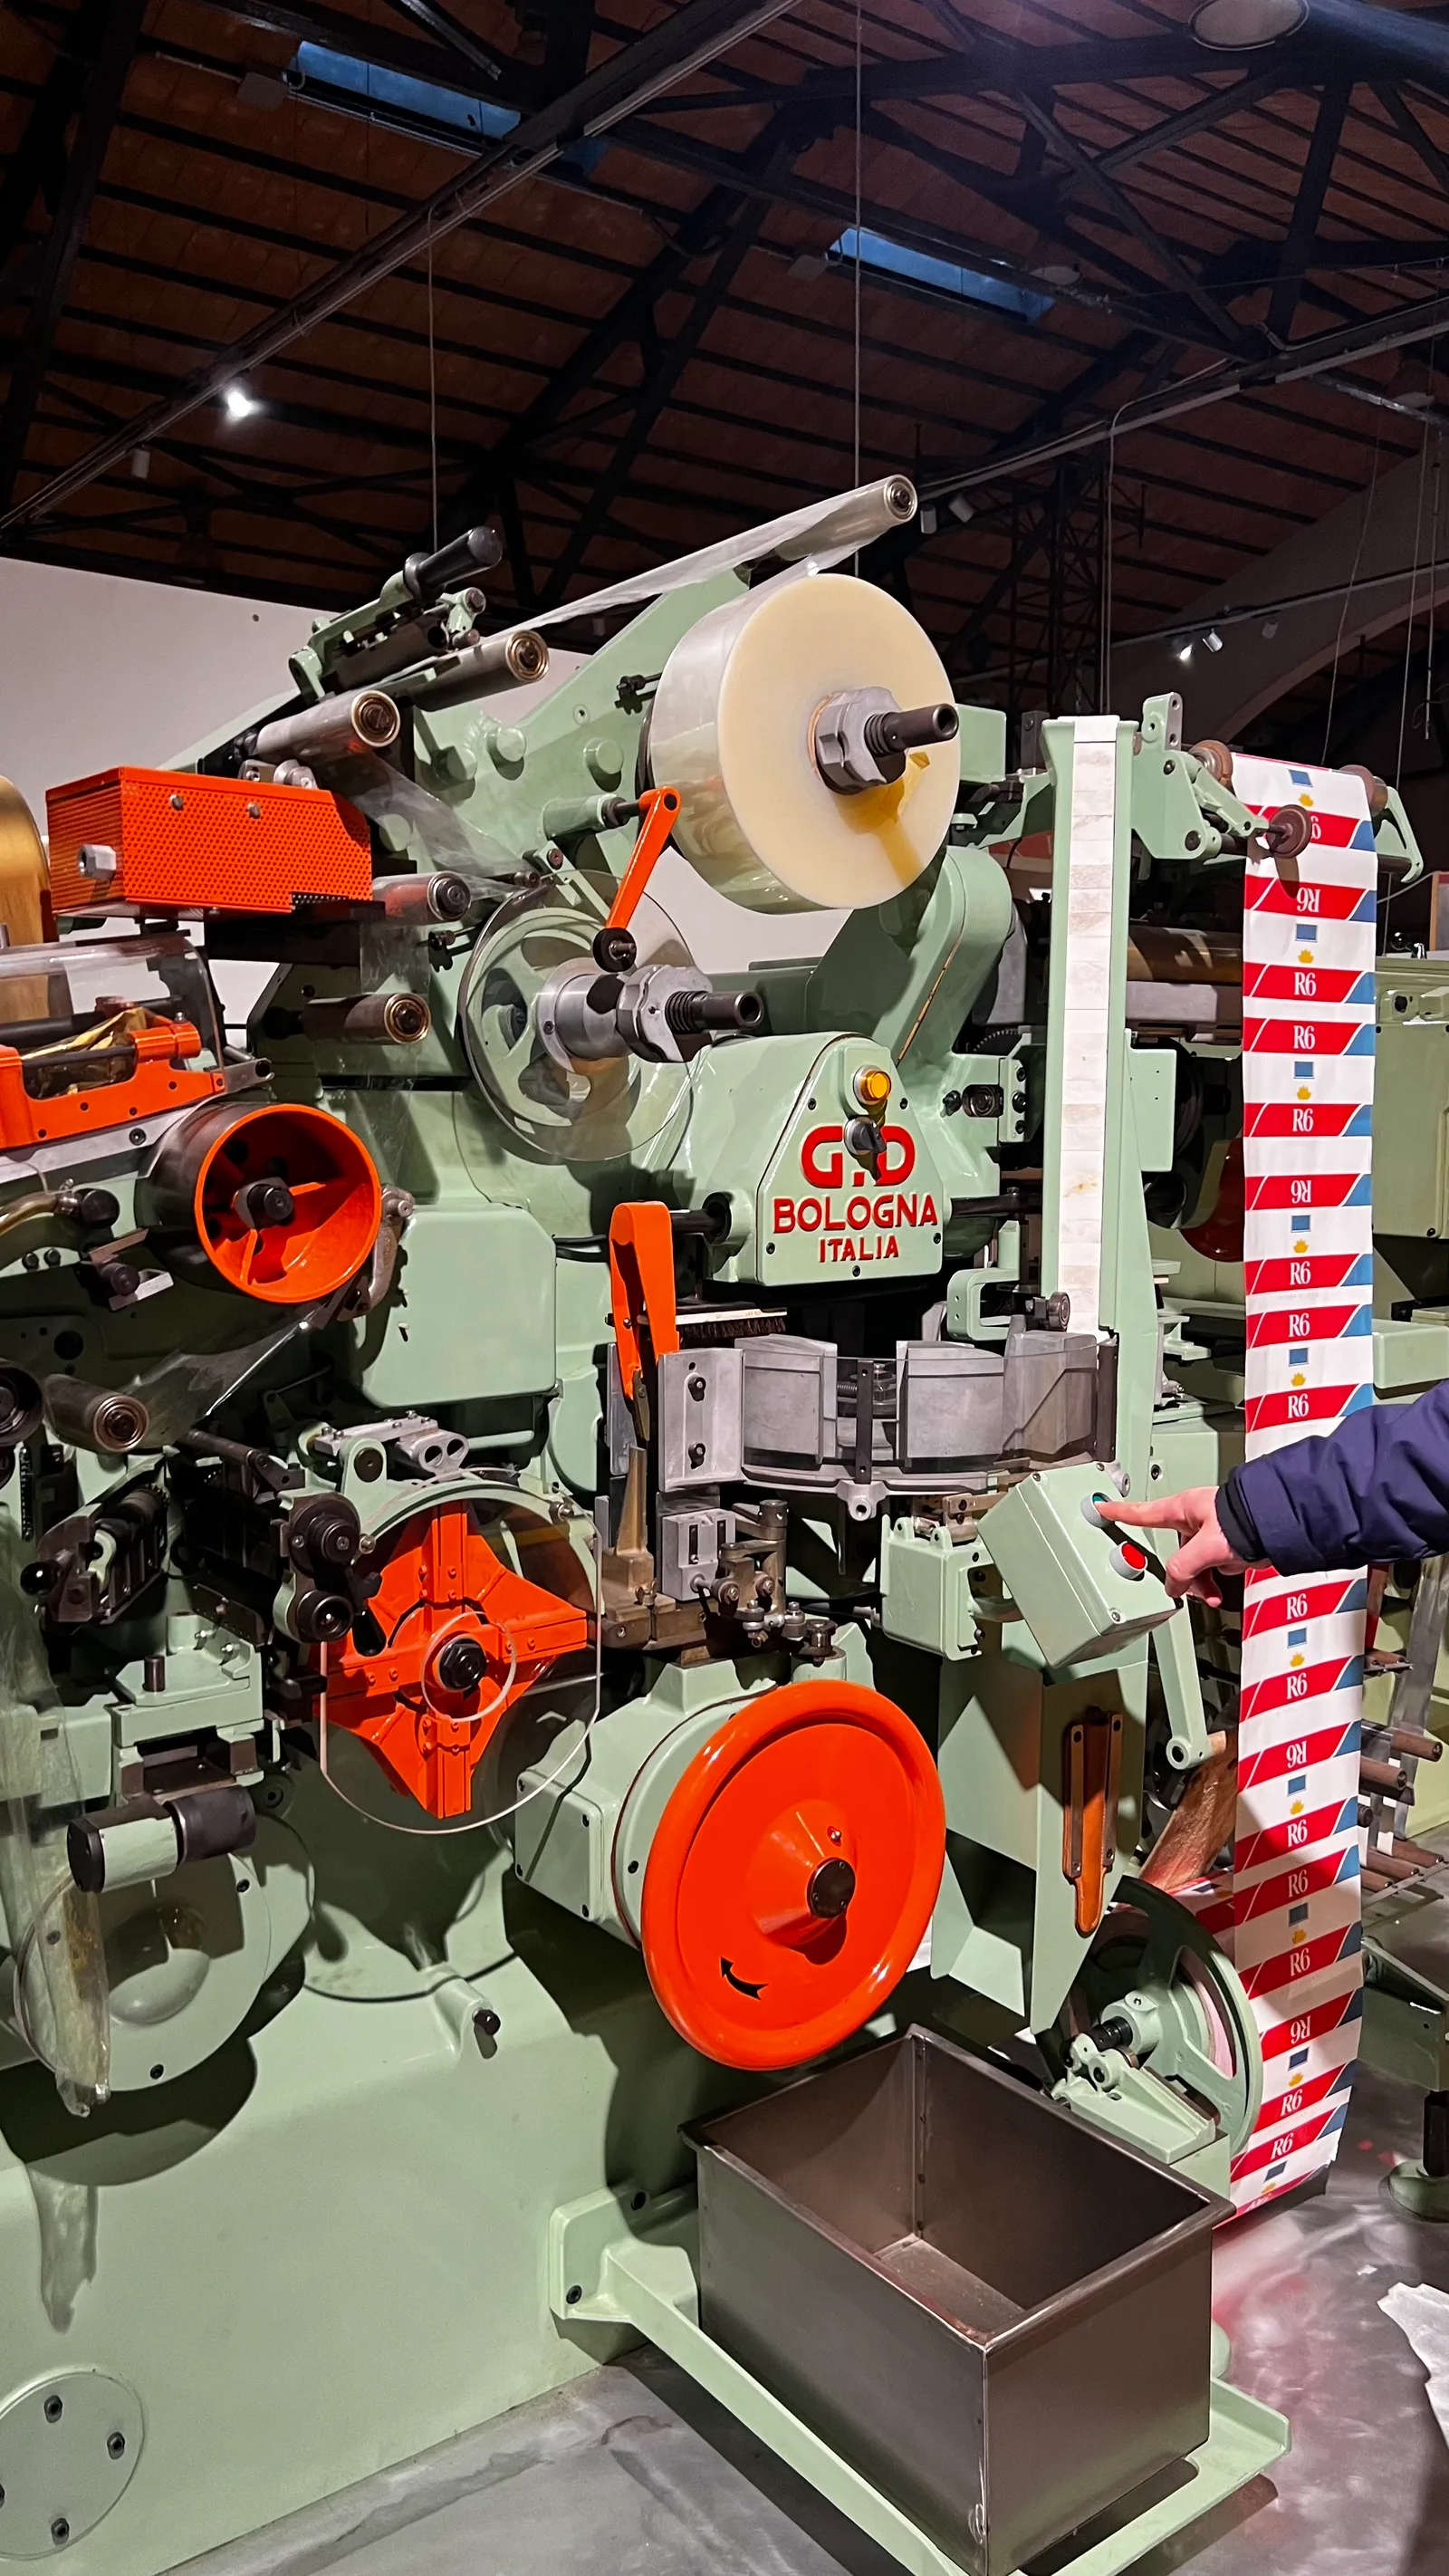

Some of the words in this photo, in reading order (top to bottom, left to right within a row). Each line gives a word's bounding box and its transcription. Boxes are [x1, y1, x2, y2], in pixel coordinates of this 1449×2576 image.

[1296, 887, 1321, 913] R6
[1293, 971, 1317, 996] R6
[1293, 1024, 1316, 1050] R6
[1291, 1108, 1314, 1132] R6
[1291, 1179, 1312, 1204] R6
[772, 1193, 938, 1234] BOLOGNA
[819, 1235, 899, 1263] ITALIA
[1290, 1260, 1311, 1285] R6
[1288, 1312, 1310, 1338] R6
[1287, 1393, 1310, 1419] R6
[1286, 1592, 1309, 1620] R6
[1286, 1672, 1308, 1700] R6
[1285, 1740, 1308, 1769] R6
[1287, 1819, 1309, 1848] R6
[1288, 1870, 1309, 1898] R6
[1290, 1948, 1310, 1976] R6
[1290, 2015, 1311, 2044] R6
[1280, 2089, 1303, 2117] R6
[1270, 2132, 1294, 2160] R6
